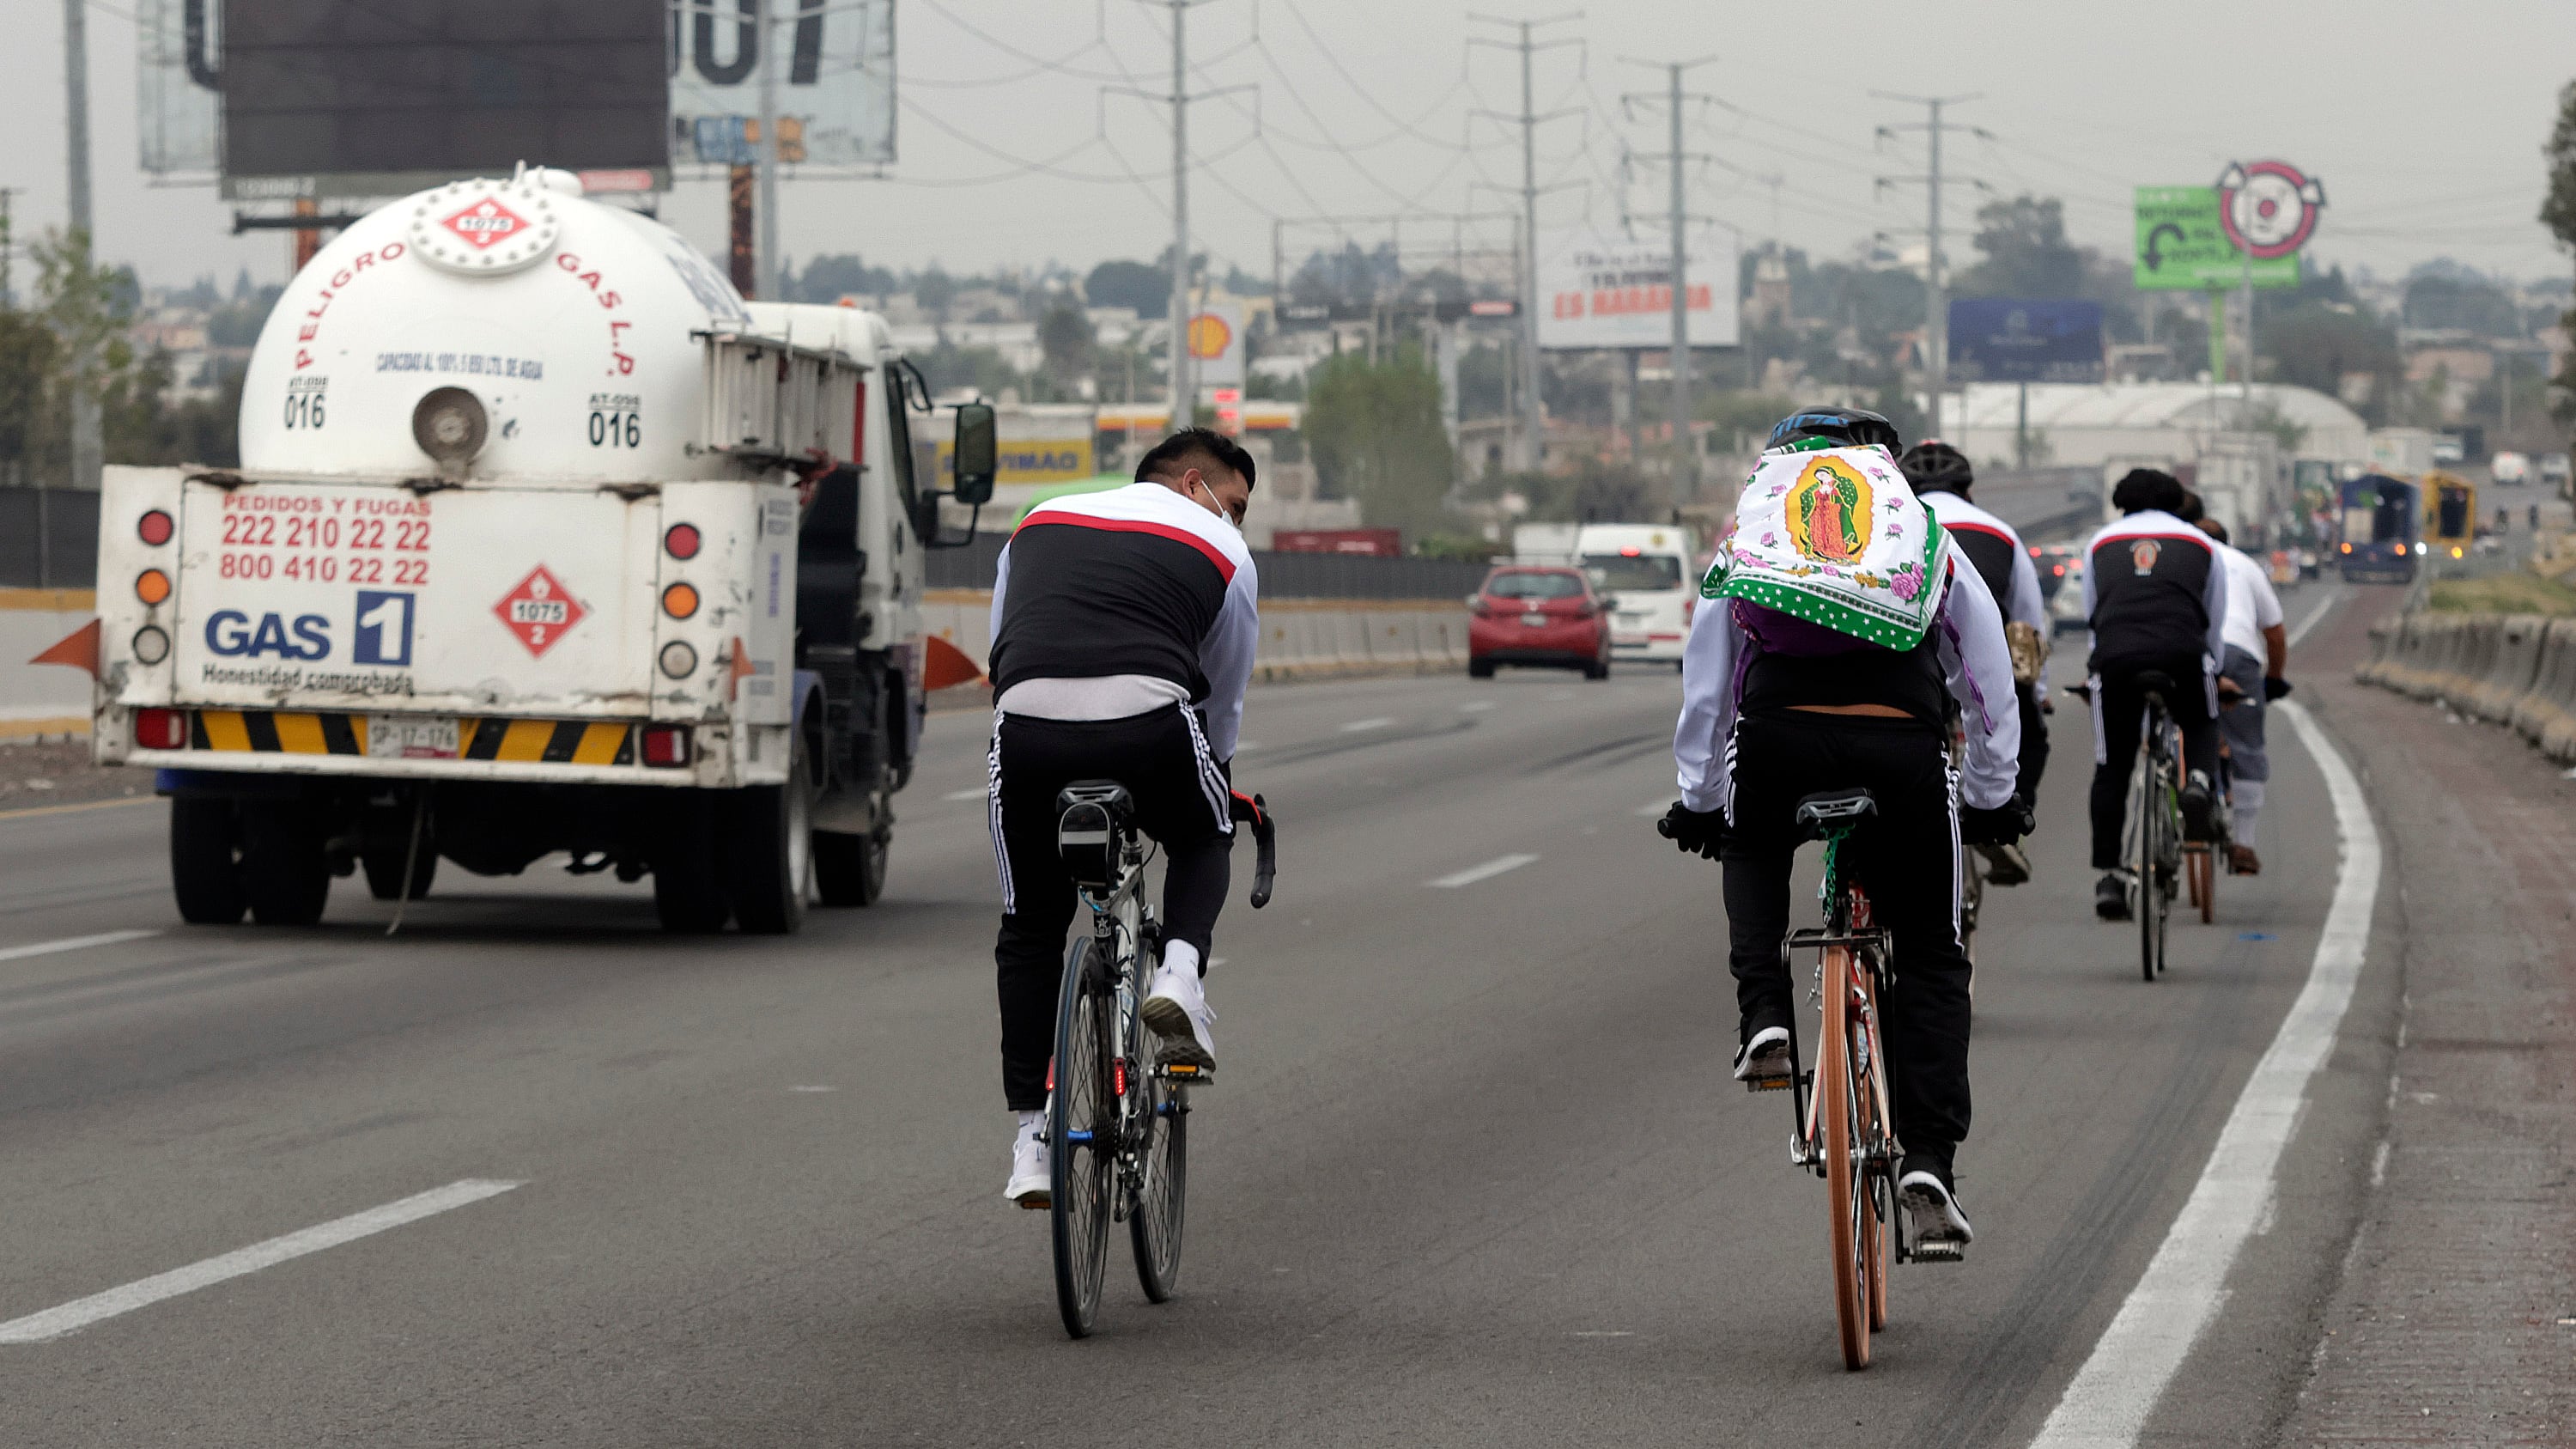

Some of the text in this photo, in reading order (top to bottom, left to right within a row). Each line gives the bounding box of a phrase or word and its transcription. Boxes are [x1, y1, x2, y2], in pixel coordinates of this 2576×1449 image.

[465, 218, 510, 230] 1075
[557, 253, 622, 309] GAS
[295, 242, 405, 370] PELIGRO
[285, 394, 325, 429] 016
[589, 411, 641, 447] 016
[222, 494, 432, 516] PEDIDOS Y FUGAS
[222, 515, 431, 551] 222 210 22 22
[220, 553, 429, 585] 800 410 22 22
[515, 602, 564, 622] 1075
[204, 609, 331, 661] GAS
[531, 626, 544, 645] 2
[202, 663, 415, 695] Honestidad comprobada
